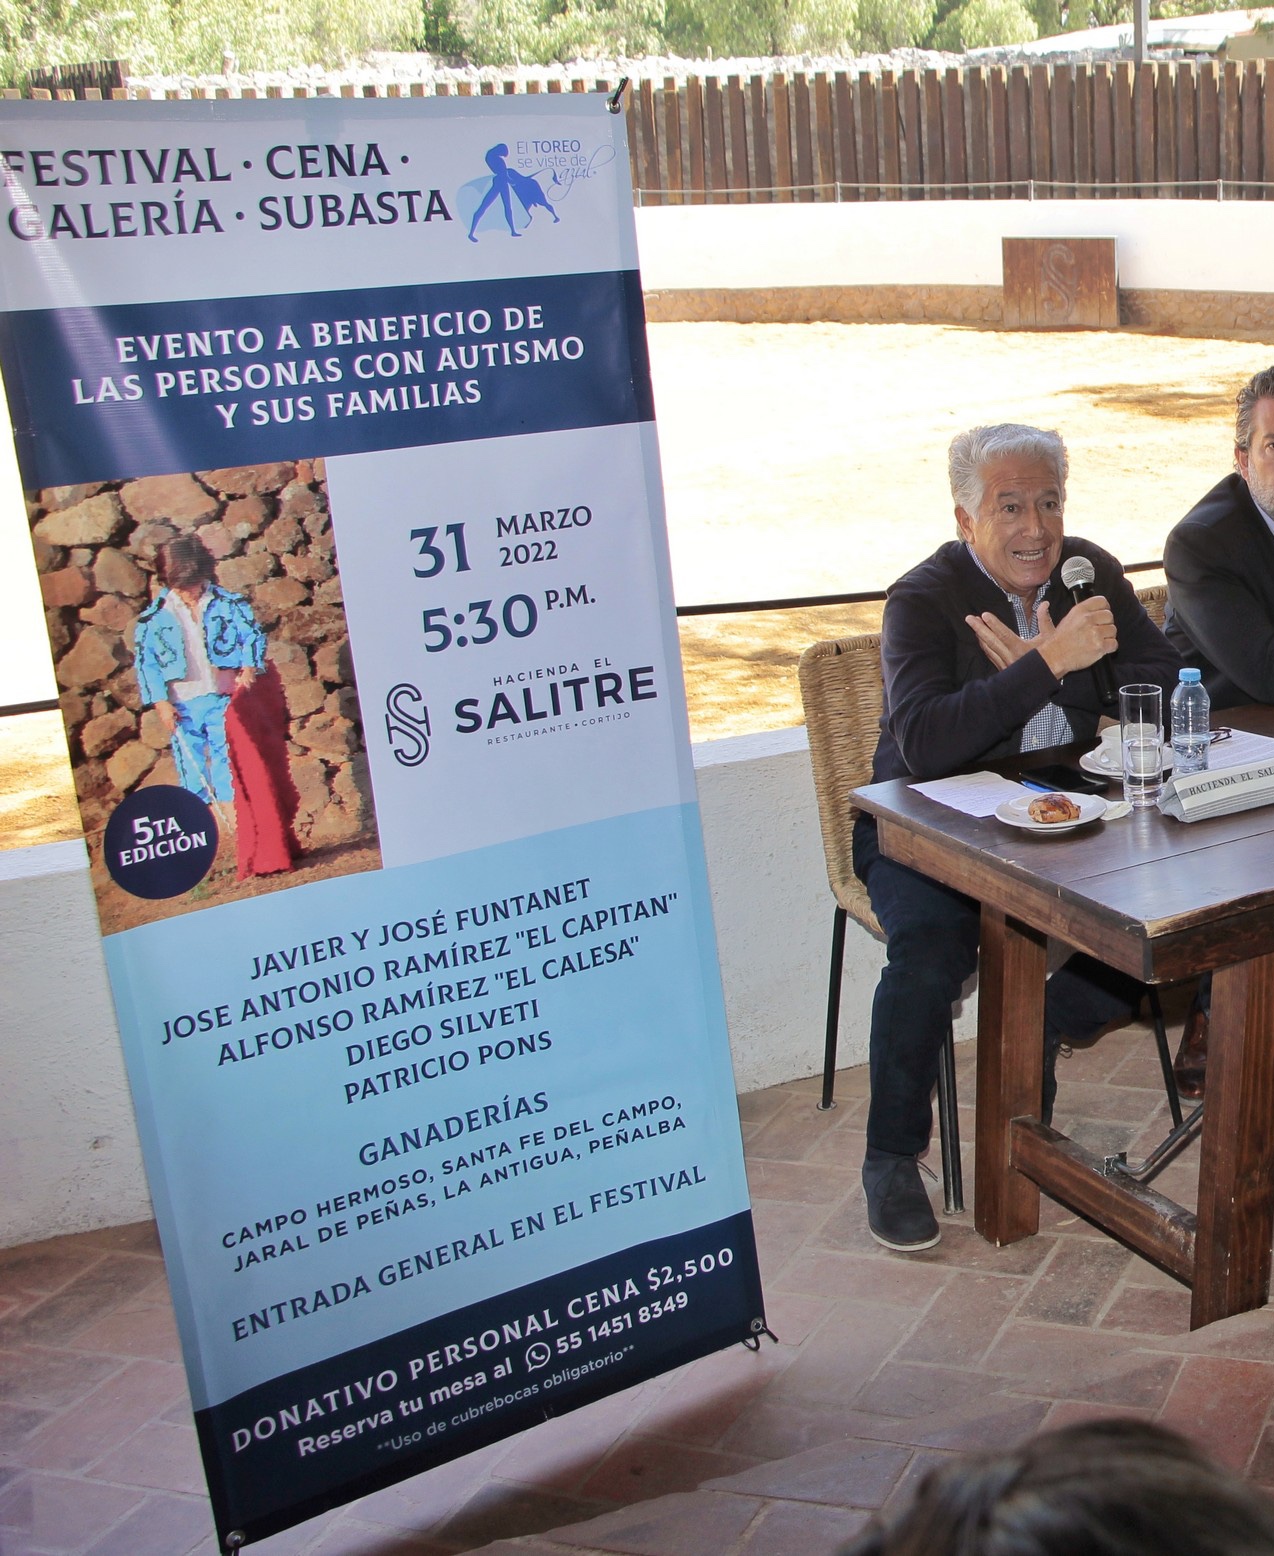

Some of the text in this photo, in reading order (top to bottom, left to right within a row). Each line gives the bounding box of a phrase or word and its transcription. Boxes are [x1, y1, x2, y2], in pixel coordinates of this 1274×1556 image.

[0, 142, 392, 188] FESTIVAL CENA
[516, 139, 581, 155] El TOREO
[517, 154, 588, 169] se viste de
[8, 189, 454, 242] GALERÍA SUBASTA
[116, 304, 546, 364] EVENTO A BENEFICIO DE
[72, 335, 586, 406] LAS PERSONAS CON AUTISMO
[215, 378, 483, 430] Y SUS FAMILIAS
[410, 505, 593, 579] 31 MARZO
[499, 540, 559, 568] 2022
[422, 584, 597, 653] 5:30 P.M.
[454, 665, 658, 734] SALITRE
[493, 657, 612, 687] HACIENDA EL
[487, 711, 632, 746] RESTAURANTE CORTIJO
[1189, 776, 1237, 796] HACIENDA
[1240, 770, 1254, 782] EL
[118, 831, 208, 867] EDICIÓN
[132, 815, 182, 846] 5TA
[249, 877, 592, 981] JAVIER Y JOSÉ FUNTANET
[160, 892, 678, 1046] JOSE ANTONIO RAMÍREZ "EL CAPITAN"
[217, 935, 641, 1067] ALFONSO RAMÍREZ "EL CALESA"
[344, 1030, 554, 1105] PATRICIO PONS
[345, 998, 541, 1068] DIEGO SILVETI
[358, 1091, 550, 1167] GANADERÍAS
[222, 1095, 683, 1250] CAMPO HERMOSO, SANTA FE DEL CAMPO,
[233, 1115, 687, 1274] JARAL DE PEÑAS, LA ANTIGUA, PEÑALBA
[232, 1164, 707, 1343] ENTRADA GENERAL EN EL FESTIVAL
[231, 1246, 735, 1454] DONATIVO PERSONAL CENA $2,500
[297, 1290, 691, 1458] Reserva tu mesa al 55 1451 8349
[426, 1418, 448, 1437] de
[451, 1383, 541, 1431] cubrebocas
